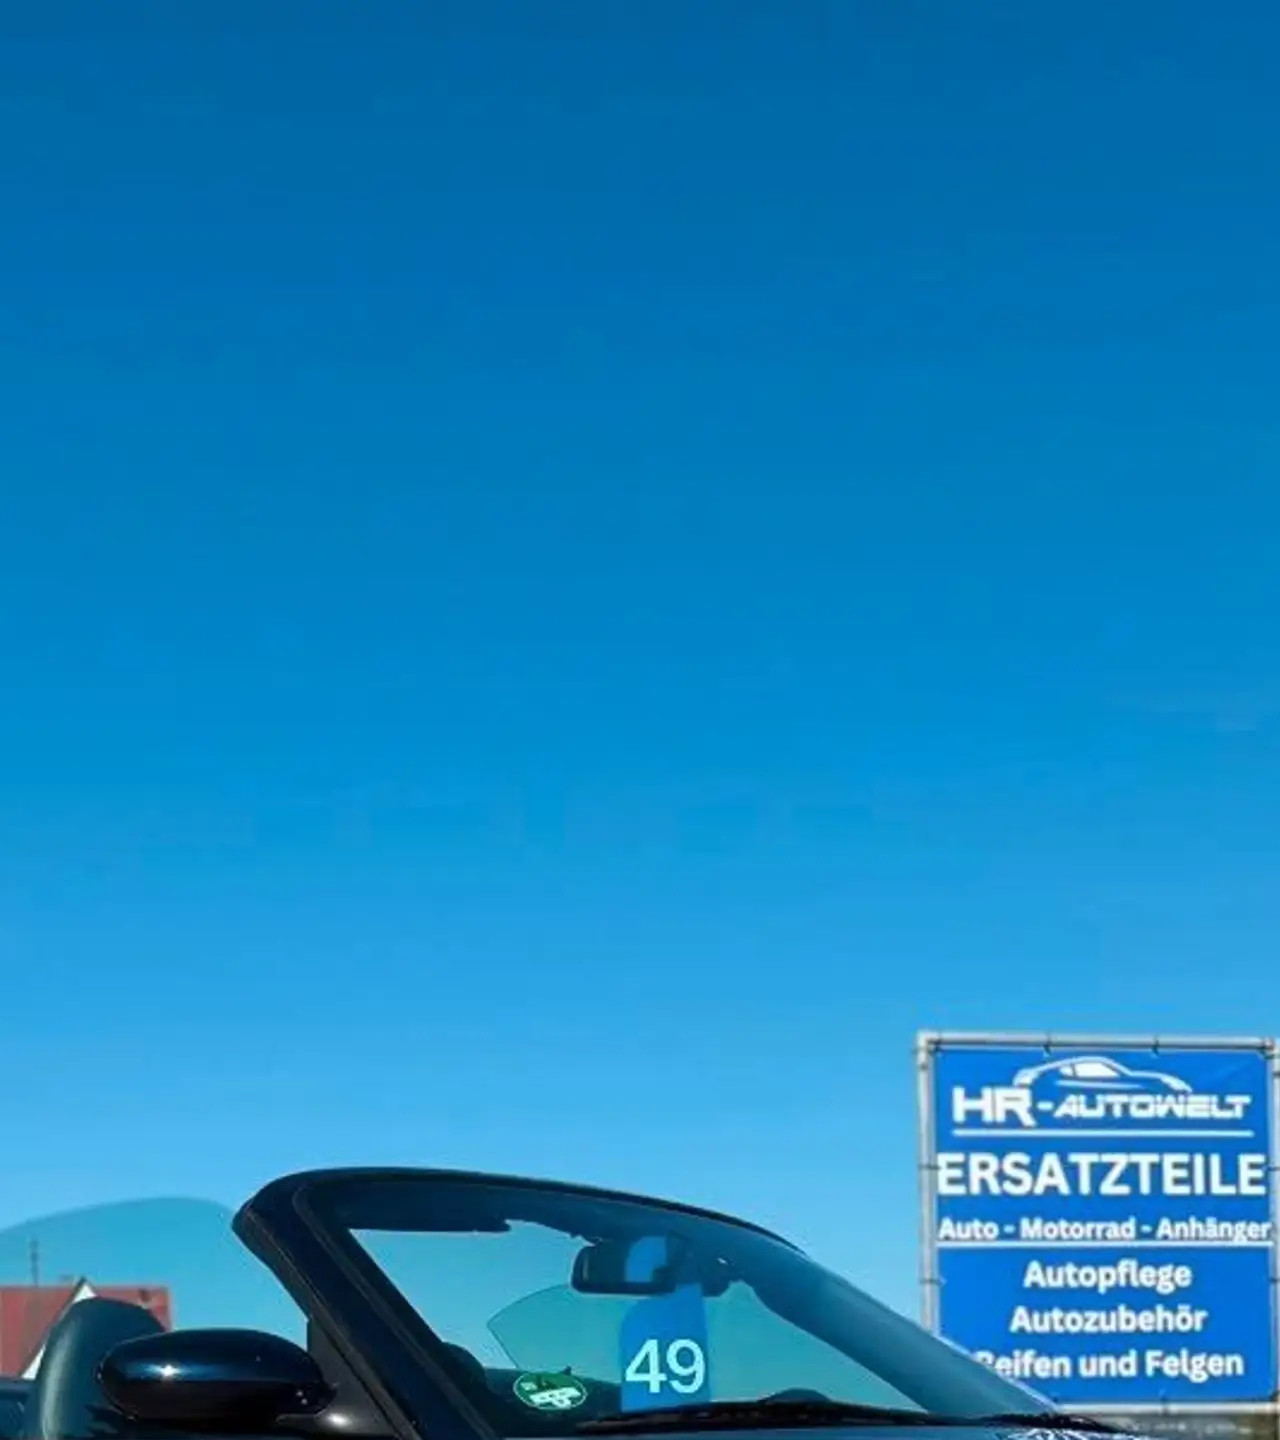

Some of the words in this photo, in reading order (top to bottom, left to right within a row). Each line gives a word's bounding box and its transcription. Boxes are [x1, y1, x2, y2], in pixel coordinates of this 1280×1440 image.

[937, 1153, 1266, 1196] ERSATZTEILE
[938, 1218, 999, 1241] Auto
[1020, 1218, 1135, 1241] Motorrad
[1156, 1218, 1272, 1244] Anhänger
[1024, 1260, 1192, 1294] Autopflege
[1010, 1305, 1208, 1333] Autozubehör
[625, 1339, 706, 1394] 49
[1079, 1350, 1138, 1378] und
[1146, 1350, 1244, 1384] Felgen
